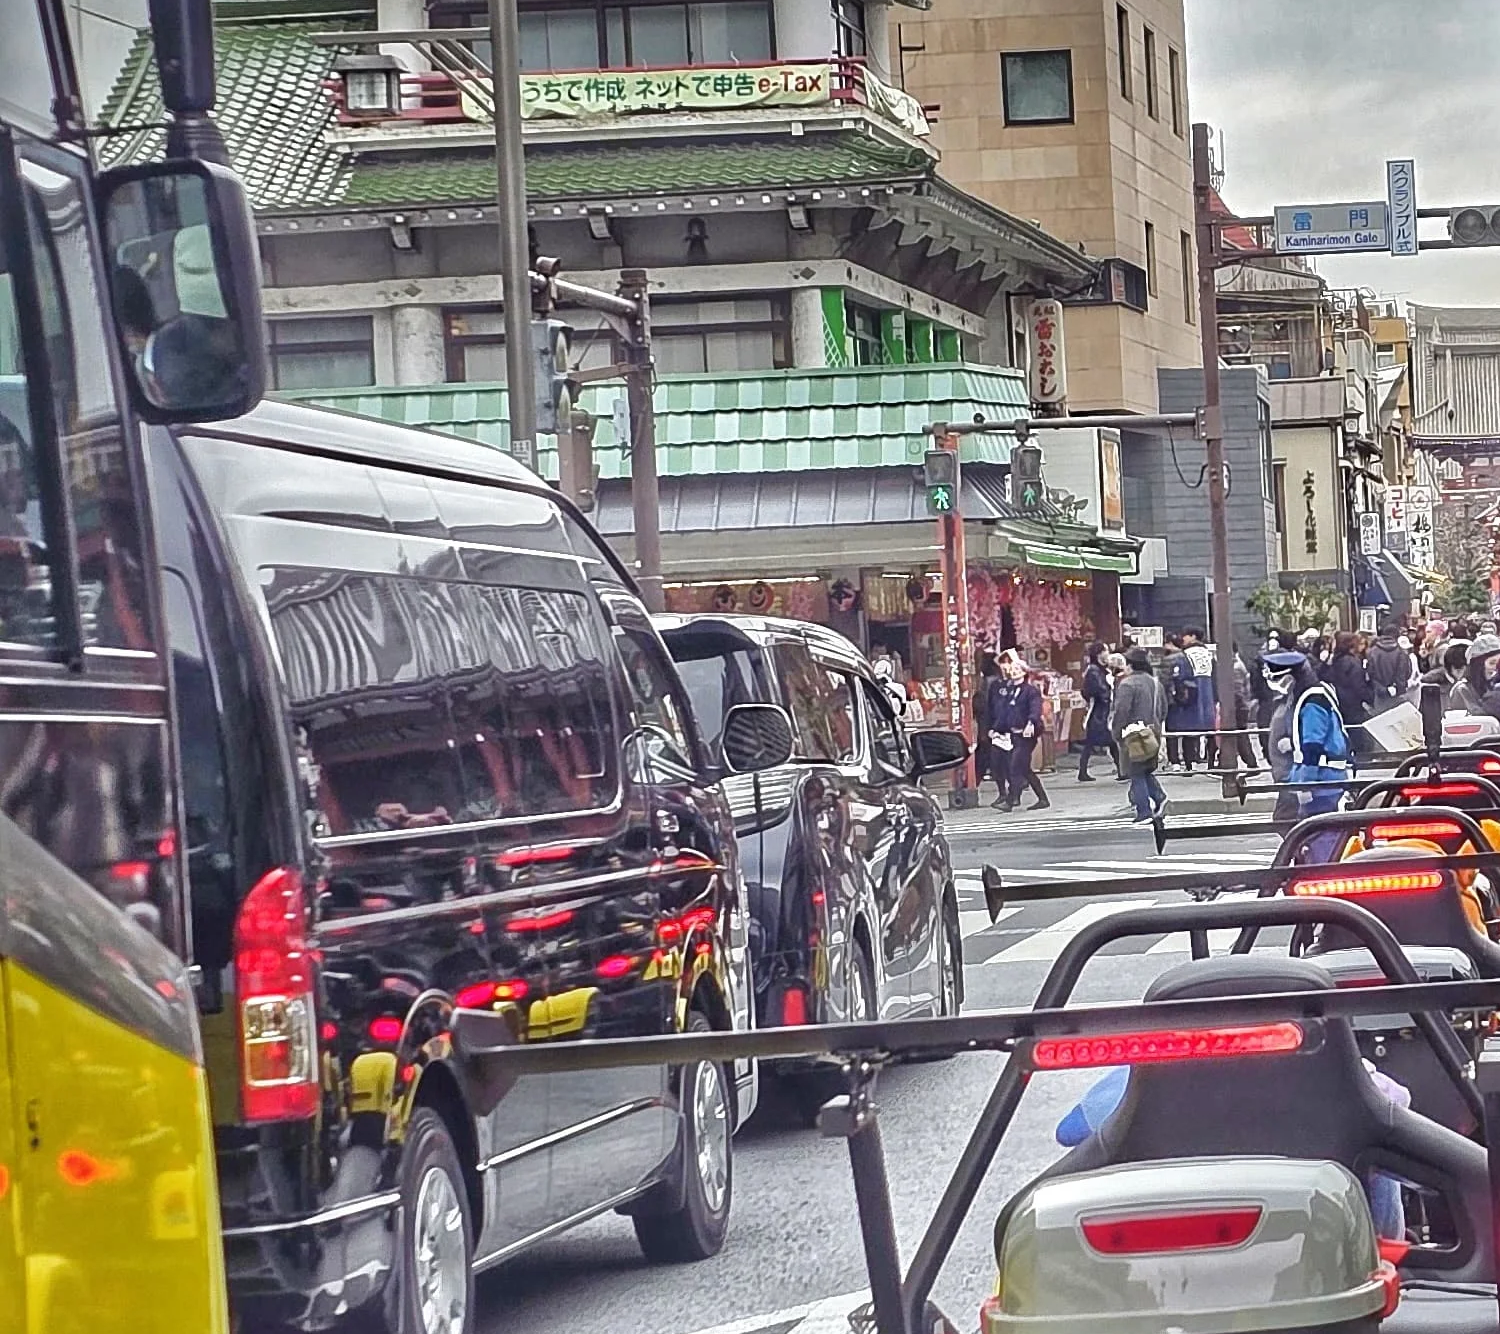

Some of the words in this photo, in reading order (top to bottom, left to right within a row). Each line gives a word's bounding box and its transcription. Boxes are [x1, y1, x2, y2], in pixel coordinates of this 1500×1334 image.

[522, 78, 627, 102] うちで作成
[636, 74, 754, 100] ネットで申告
[758, 71, 822, 93] e-Tax
[1285, 234, 1351, 247] Kaminarimon
[1354, 233, 1378, 244] Gate
